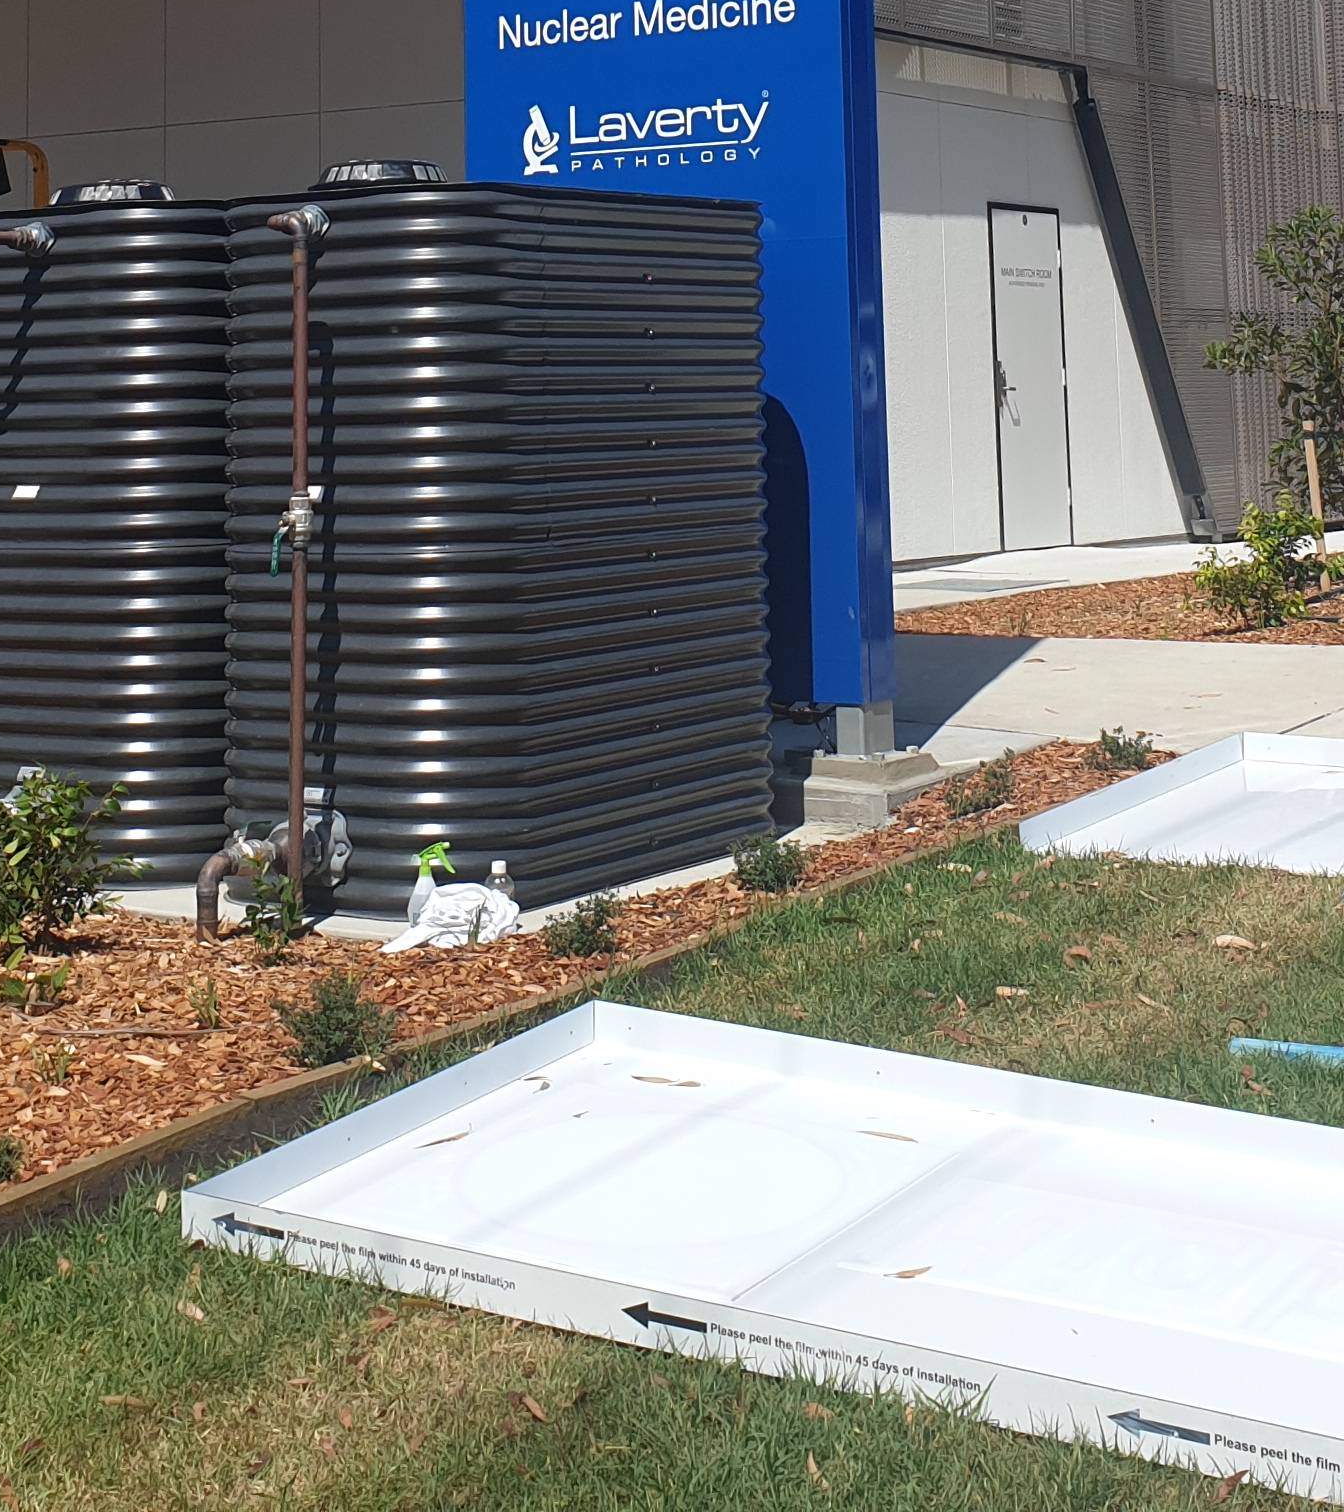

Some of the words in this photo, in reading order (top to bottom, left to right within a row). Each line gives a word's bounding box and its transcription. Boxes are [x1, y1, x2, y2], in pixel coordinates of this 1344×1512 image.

[498, 8, 623, 49] Nuclear
[569, 98, 769, 145] Laverty
[571, 147, 761, 173] PATHOLOGY
[287, 1231, 317, 1247] Please
[320, 1238, 339, 1251] peel
[341, 1243, 356, 1255] the
[359, 1247, 376, 1260] film
[379, 1251, 407, 1266] within
[410, 1258, 421, 1269] 45
[424, 1261, 446, 1276] days
[449, 1267, 458, 1277] of
[461, 1268, 516, 1291] installation
[710, 1323, 746, 1340] Please
[749, 1331, 772, 1345] peel
[774, 1337, 793, 1350] the
[795, 1342, 815, 1356] film
[819, 1348, 852, 1365] within
[856, 1354, 869, 1367] 45
[872, 1358, 898, 1375] days
[902, 1366, 914, 1378] of
[917, 1367, 981, 1393] installation
[1214, 1434, 1256, 1454] Please
[1260, 1445, 1288, 1461] peel
[1292, 1452, 1312, 1467] the
[1316, 1457, 1341, 1474] film
